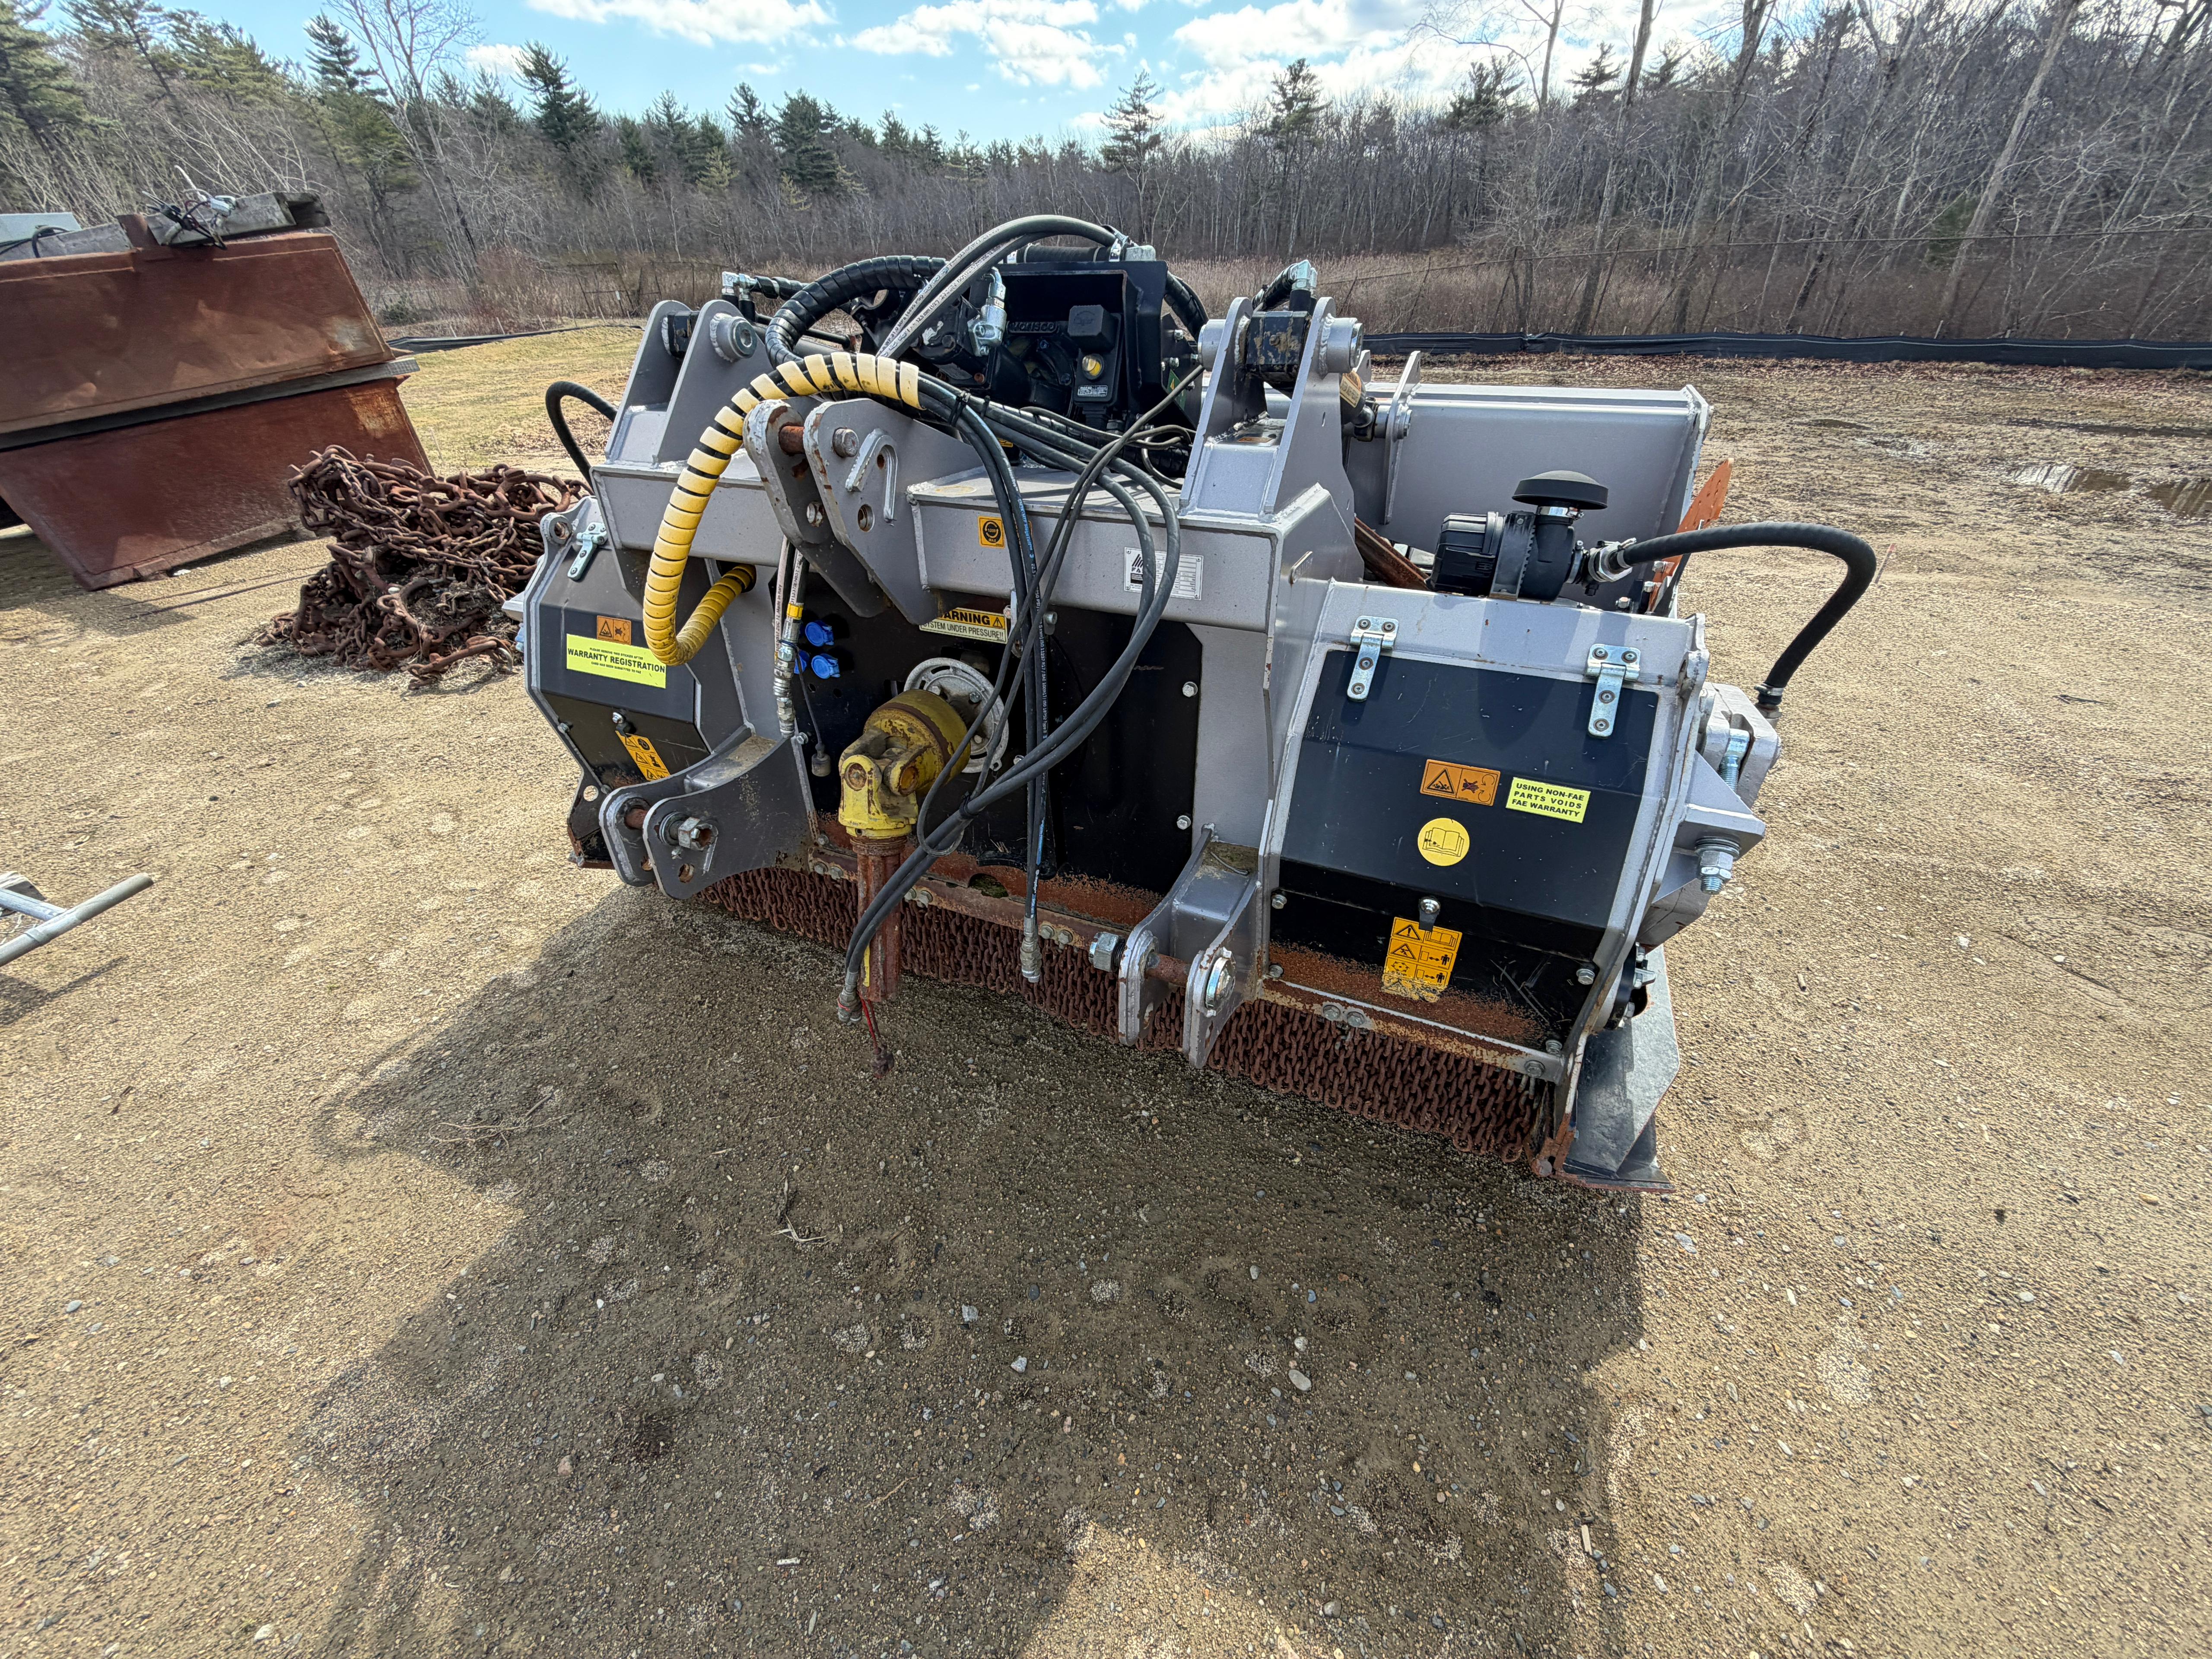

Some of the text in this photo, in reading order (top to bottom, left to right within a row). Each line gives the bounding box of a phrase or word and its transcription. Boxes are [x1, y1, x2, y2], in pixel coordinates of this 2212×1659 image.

[941, 610, 991, 626] ARNING
[947, 623, 967, 634] UNDER
[969, 626, 1004, 639] PRESSURE!!
[568, 647, 665, 674] WARRANTY REGISTRATION
[1514, 791, 1582, 809] PARTS VOIDS
[1516, 782, 1585, 801] USING NON-FAE
[1530, 802, 1580, 817] WARRANTY
